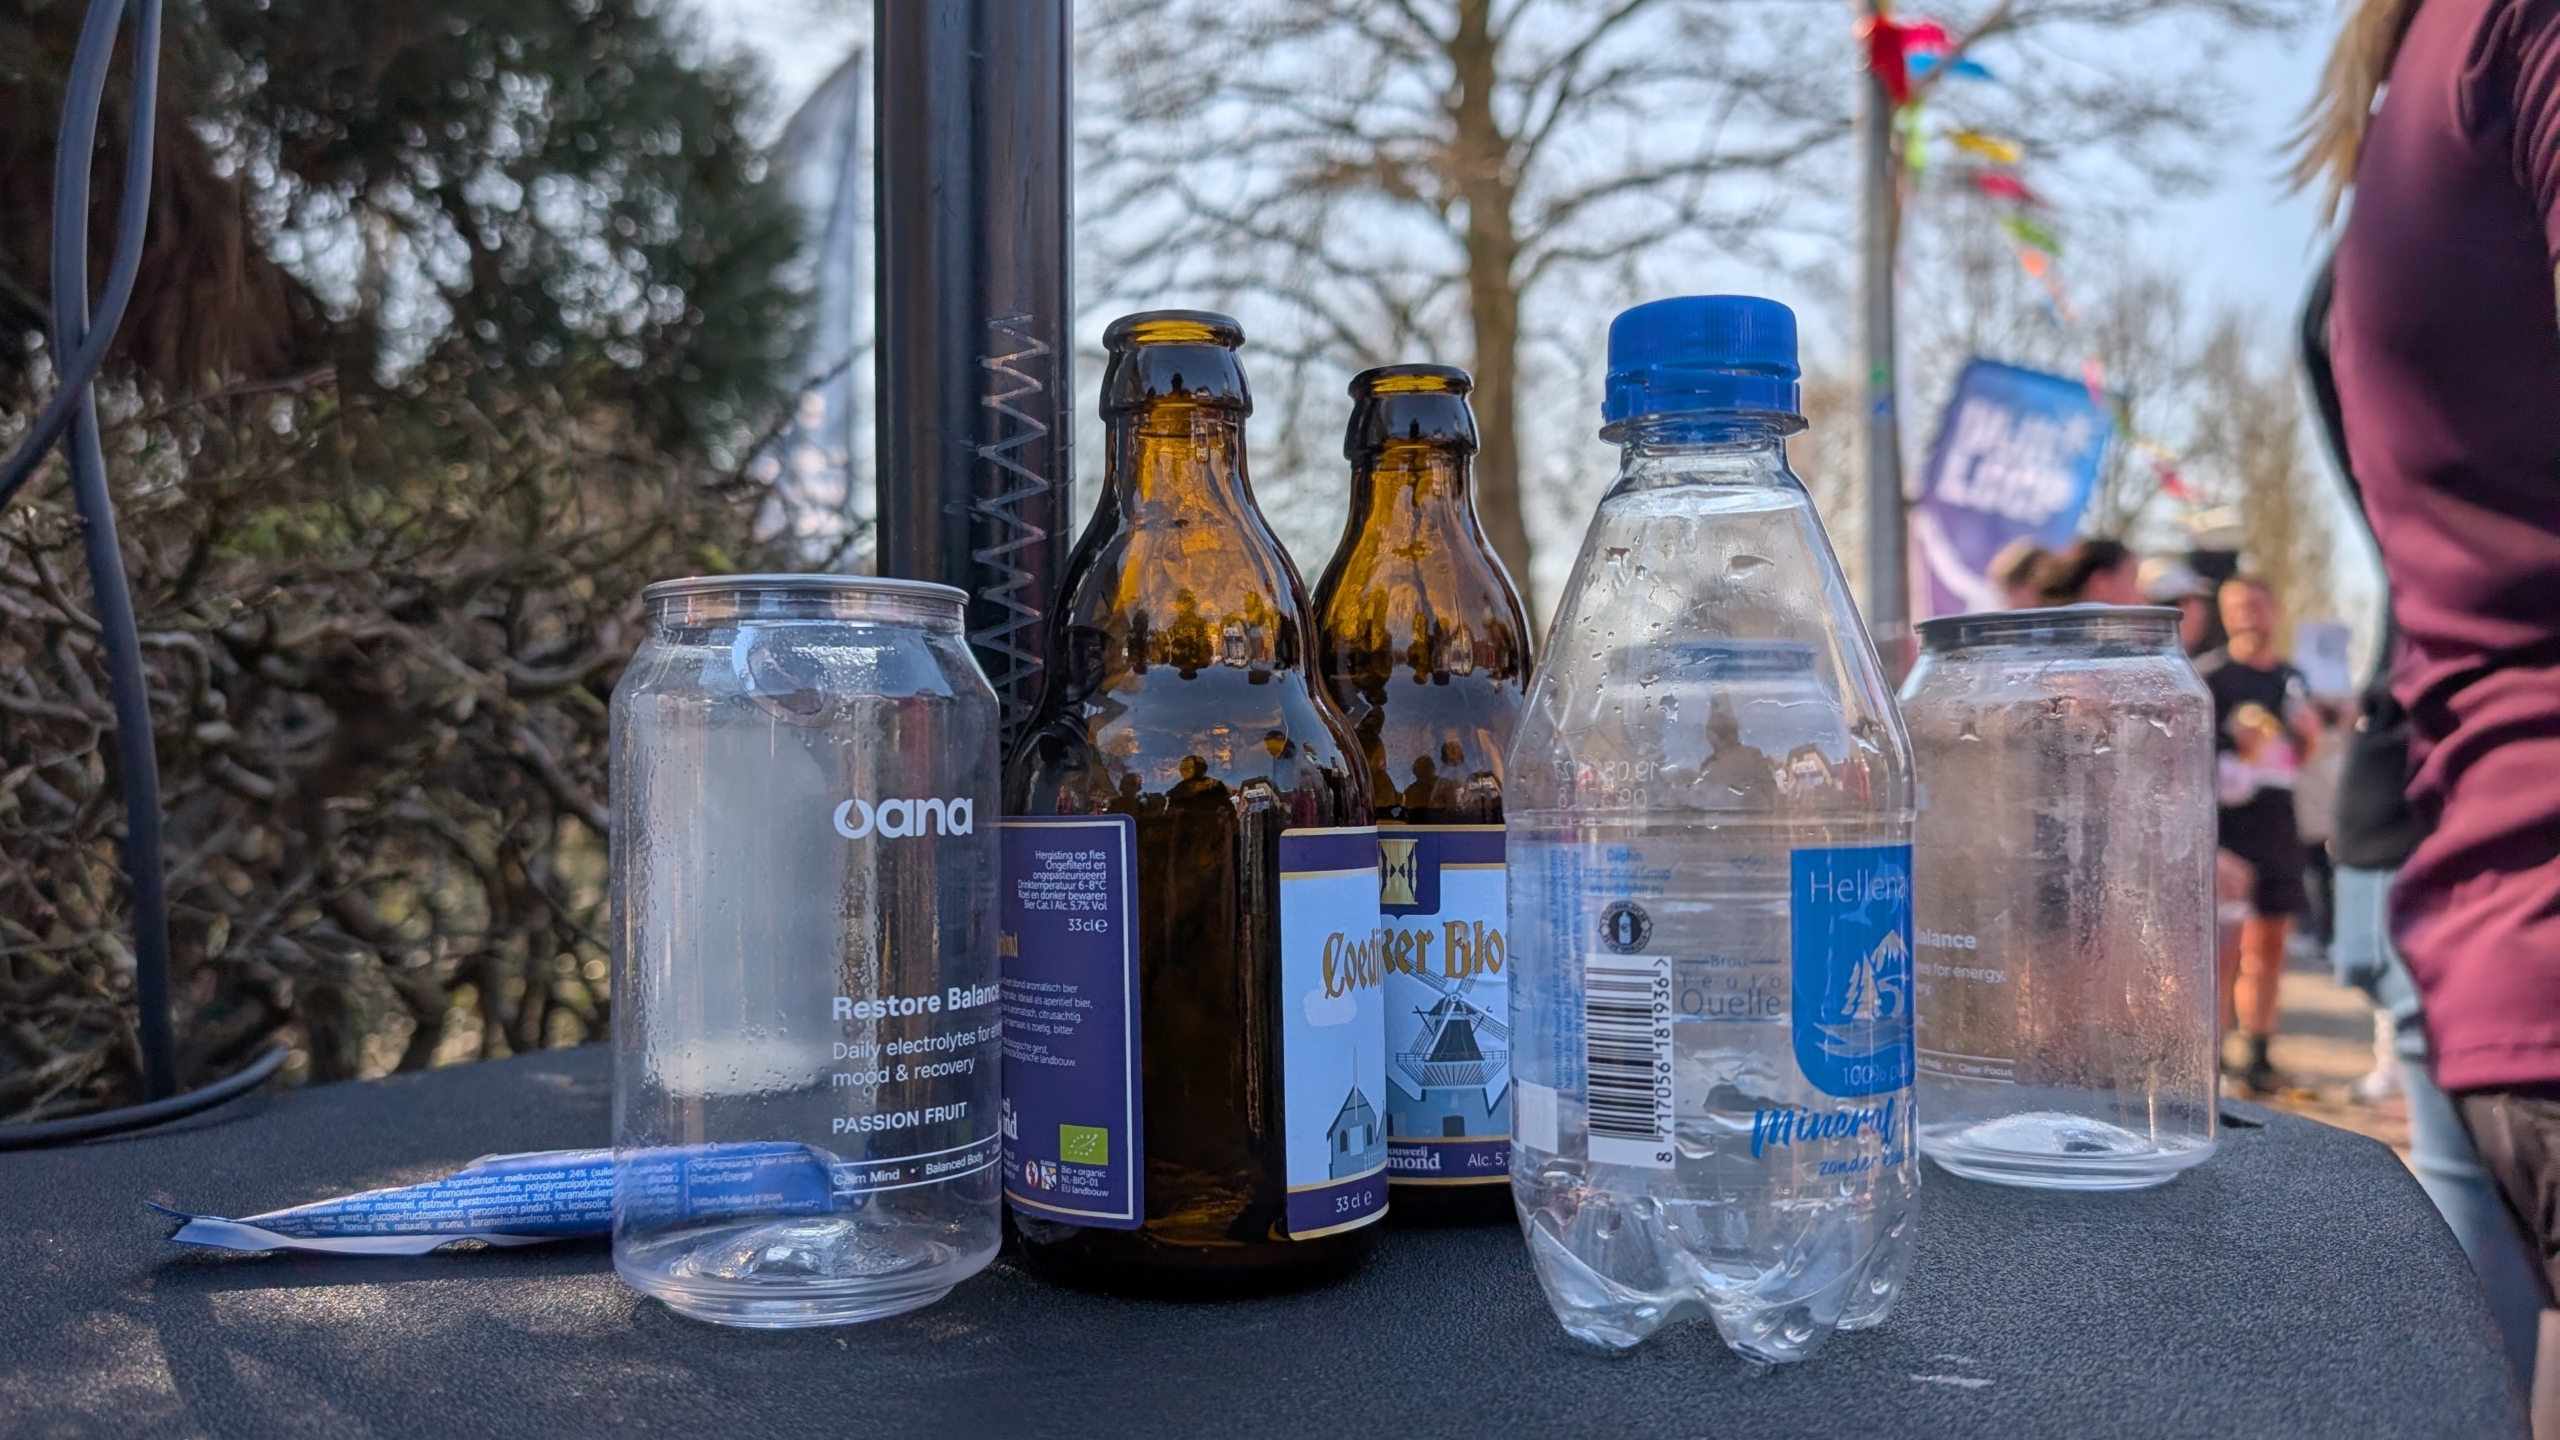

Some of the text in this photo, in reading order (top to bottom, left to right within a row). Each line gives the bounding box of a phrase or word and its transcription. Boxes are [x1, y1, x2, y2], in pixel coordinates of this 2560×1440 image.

[1035, 850, 1106, 861] Hergisting op fles
[1045, 860, 1106, 871] Ongefilterd en
[1032, 870, 1107, 881] ongepasteuriseerd
[1017, 880, 1107, 892] Drinktemperatuur 6-8°C
[1031, 891, 1039, 899] en
[1040, 891, 1066, 900] donker
[1068, 891, 1107, 901] bewaren
[1024, 900, 1035, 909] Bier
[1070, 901, 1090, 911] 5,7%
[1091, 901, 1108, 911] Vol
[1933, 962, 1950, 976] for
[1026, 982, 1060, 992] aromatisch
[1063, 984, 1078, 993] bier
[833, 994, 941, 1020] Restore
[948, 983, 1000, 1010] Balance
[1074, 998, 1093, 1009] bier,
[1680, 988, 1781, 1016] Quelle
[1038, 1010, 1083, 1023] citrusachtig.
[1053, 1024, 1075, 1035] bitter.
[833, 1041, 880, 1061] Daily
[886, 1030, 976, 1056] electrolytes
[977, 1025, 991, 1042] for
[1040, 1054, 1077, 1067] landbouw.
[833, 1057, 975, 1086] mood & recovery
[1653, 977, 1672, 1163] 8 717056 181936
[1958, 1063, 1981, 1074] Clear
[1983, 1065, 2013, 1077] Focus
[832, 1102, 967, 1134] PASSION FRUIT
[1467, 1153, 1492, 1167] Alc.
[1819, 1151, 1877, 1176] zonder
[870, 1169, 900, 1183] Mind
[926, 1157, 966, 1175] Balanced
[967, 1152, 984, 1166] Body
[1061, 1165, 1106, 1179] Bio organic
[447, 1175, 500, 1187] Ingrediënten:
[504, 1171, 565, 1182] melkchocolade
[569, 1169, 586, 1178] 24%
[1061, 1175, 1099, 1187] NL-BIO-01
[386, 1190, 428, 1200] emulgator
[431, 1184, 522, 1199] (ammoniumfosfatiden,
[1061, 1184, 1109, 1197] EU landbouw
[345, 1201, 373, 1212] suiker,
[375, 1200, 416, 1211] maismeel,
[418, 1199, 455, 1210] rijstmeel,
[457, 1193, 530, 1207] gerstmoutextract,
[533, 1192, 553, 1202] zout,
[1335, 1195, 1349, 1213] 33
[368, 1208, 466, 1223] glucose-fructosestroop,
[468, 1204, 518, 1218] geroosterde
[520, 1203, 550, 1215] pinda's
[568, 1199, 608, 1210] kokosolie,
[343, 1222, 371, 1233] honing
[394, 1221, 432, 1231] natuurlijk
[437, 1219, 466, 1229] aroma,
[471, 1214, 555, 1227] karamelsuikerstroop,
